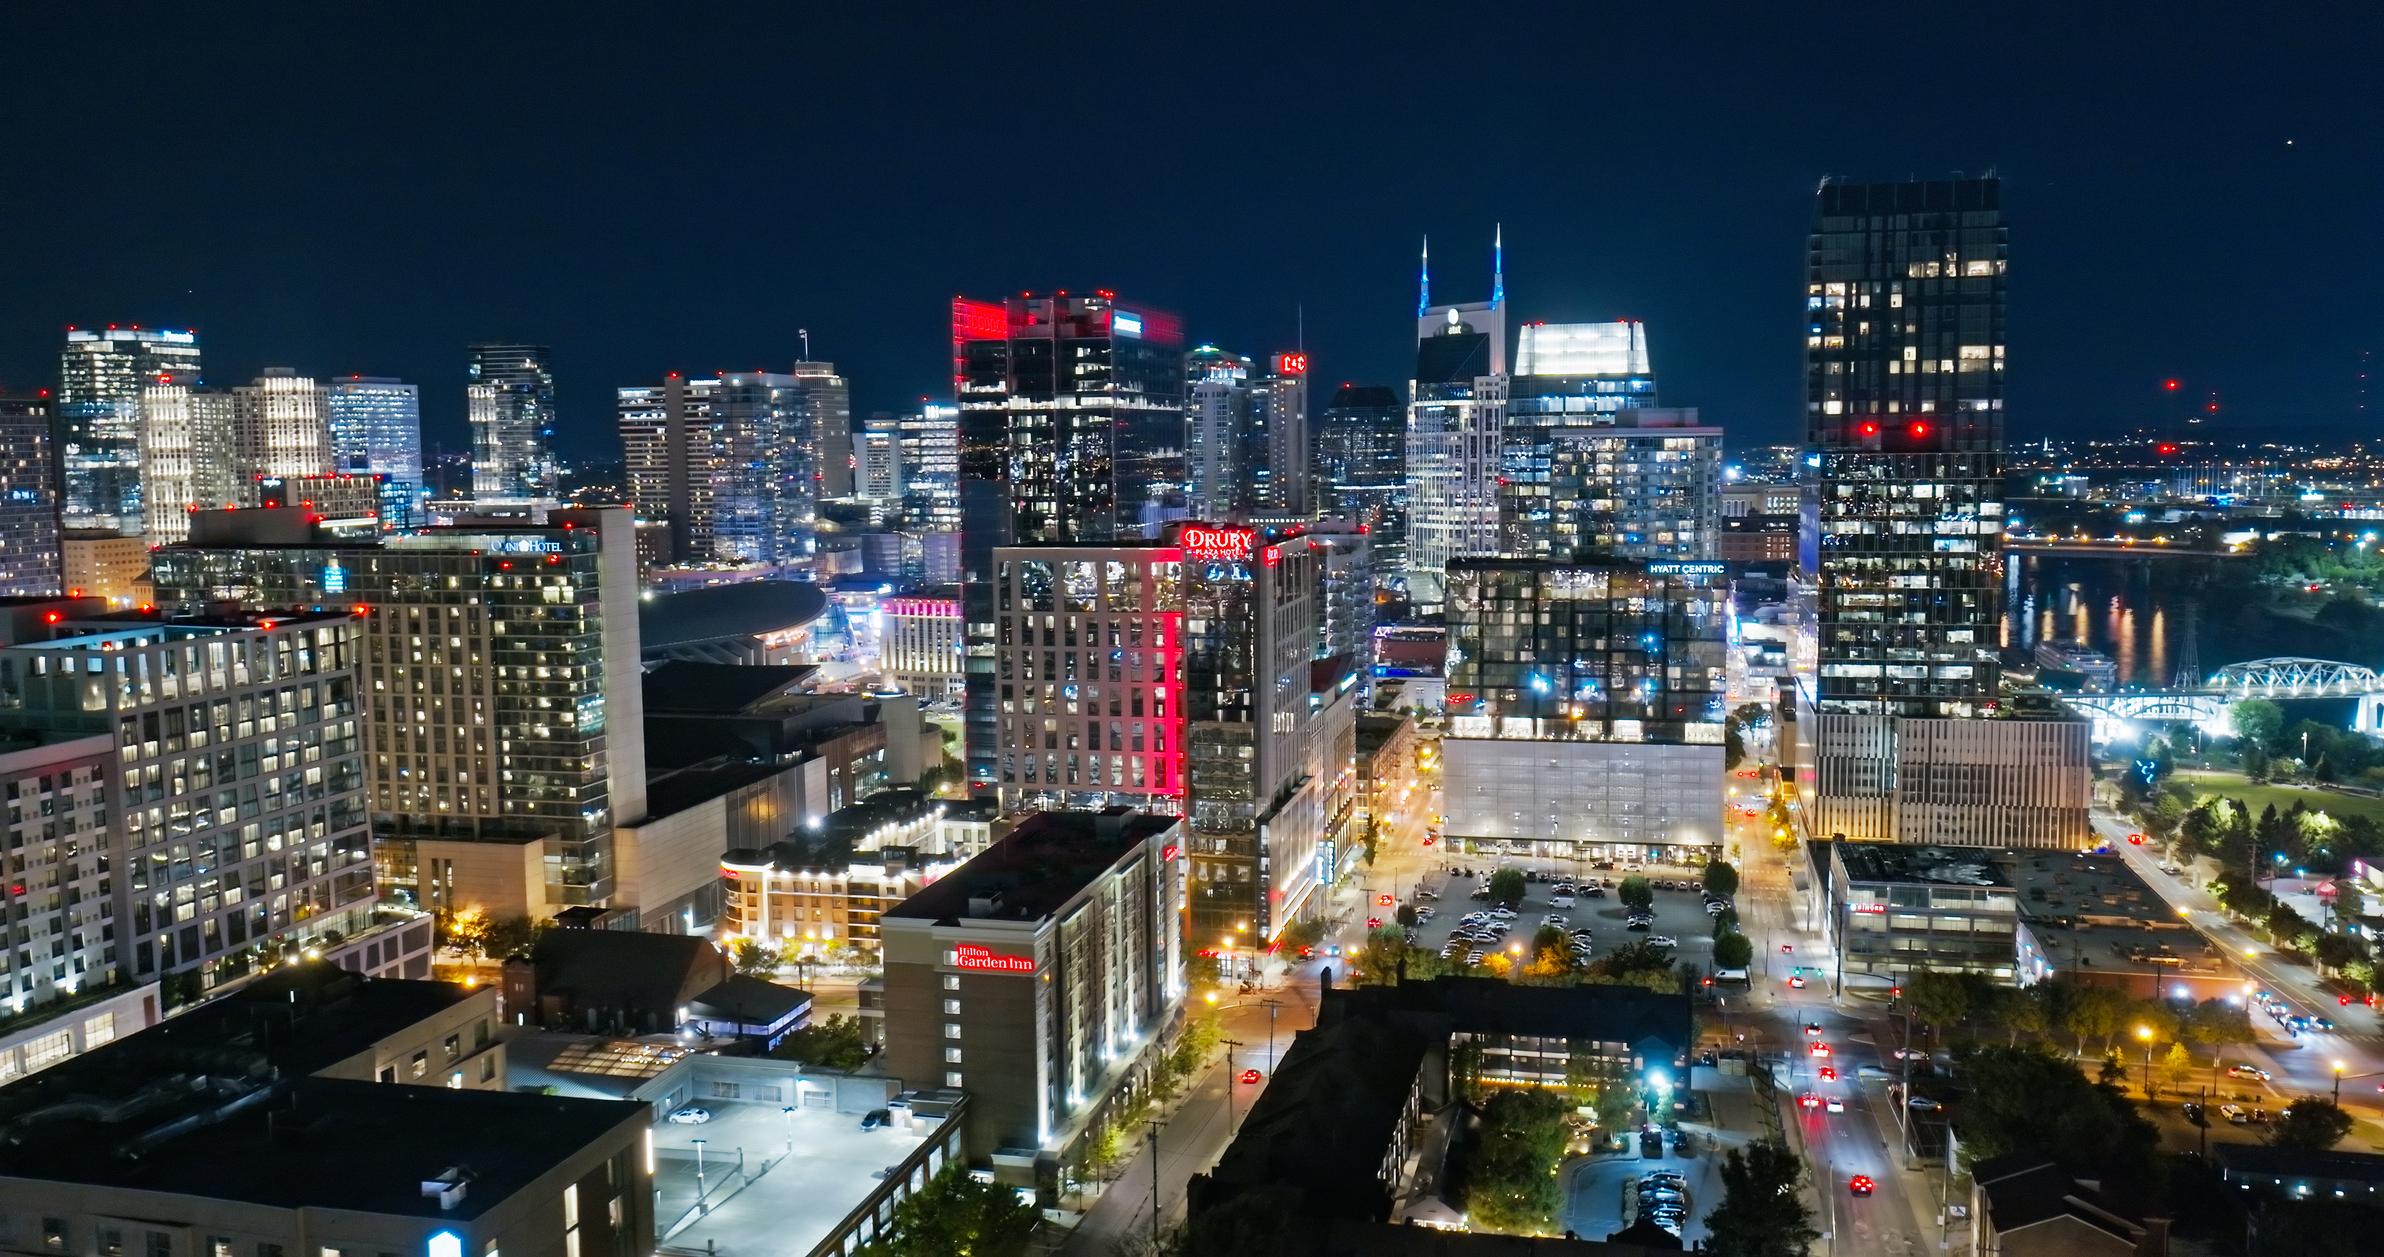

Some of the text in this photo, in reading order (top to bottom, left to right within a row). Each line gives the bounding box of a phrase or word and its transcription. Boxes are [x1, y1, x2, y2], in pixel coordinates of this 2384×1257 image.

[1185, 529, 1252, 549] DRURY
[529, 540, 563, 552] HOTEL
[1650, 564, 1725, 575] HYATT CENTRIC
[959, 946, 989, 957] Hilton
[959, 955, 1032, 970] Garden Inn
